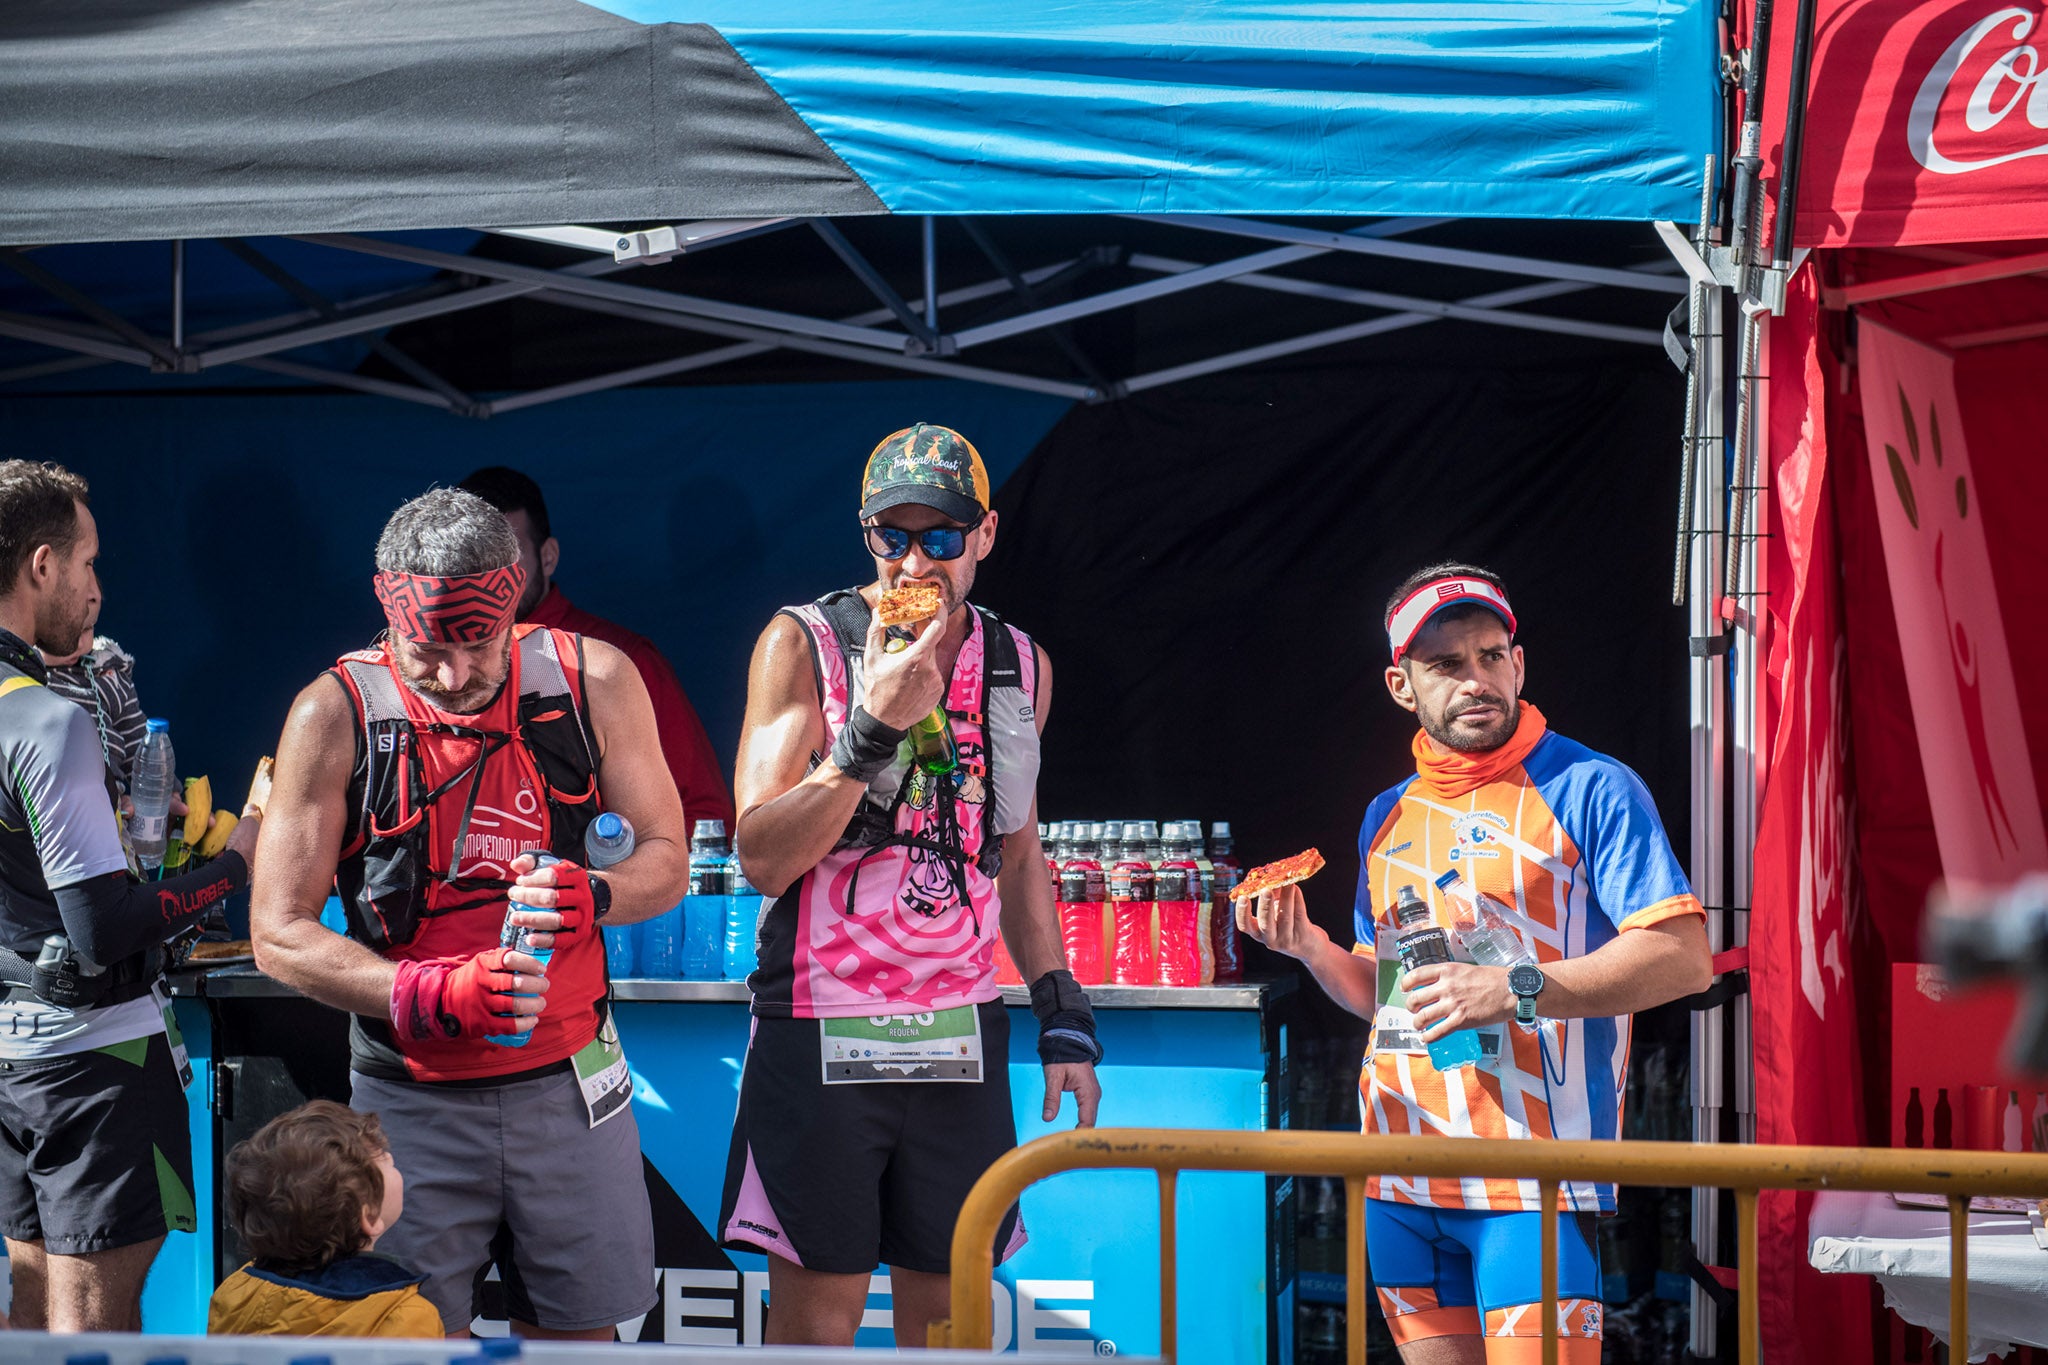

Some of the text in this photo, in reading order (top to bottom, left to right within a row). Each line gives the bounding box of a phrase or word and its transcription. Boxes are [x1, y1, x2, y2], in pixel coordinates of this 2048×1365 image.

[892, 454, 959, 472] Tropical Coast
[181, 877, 234, 914] LURBEL
[1400, 931, 1444, 950] POWERADE
[888, 1028, 920, 1038] REQUENA
